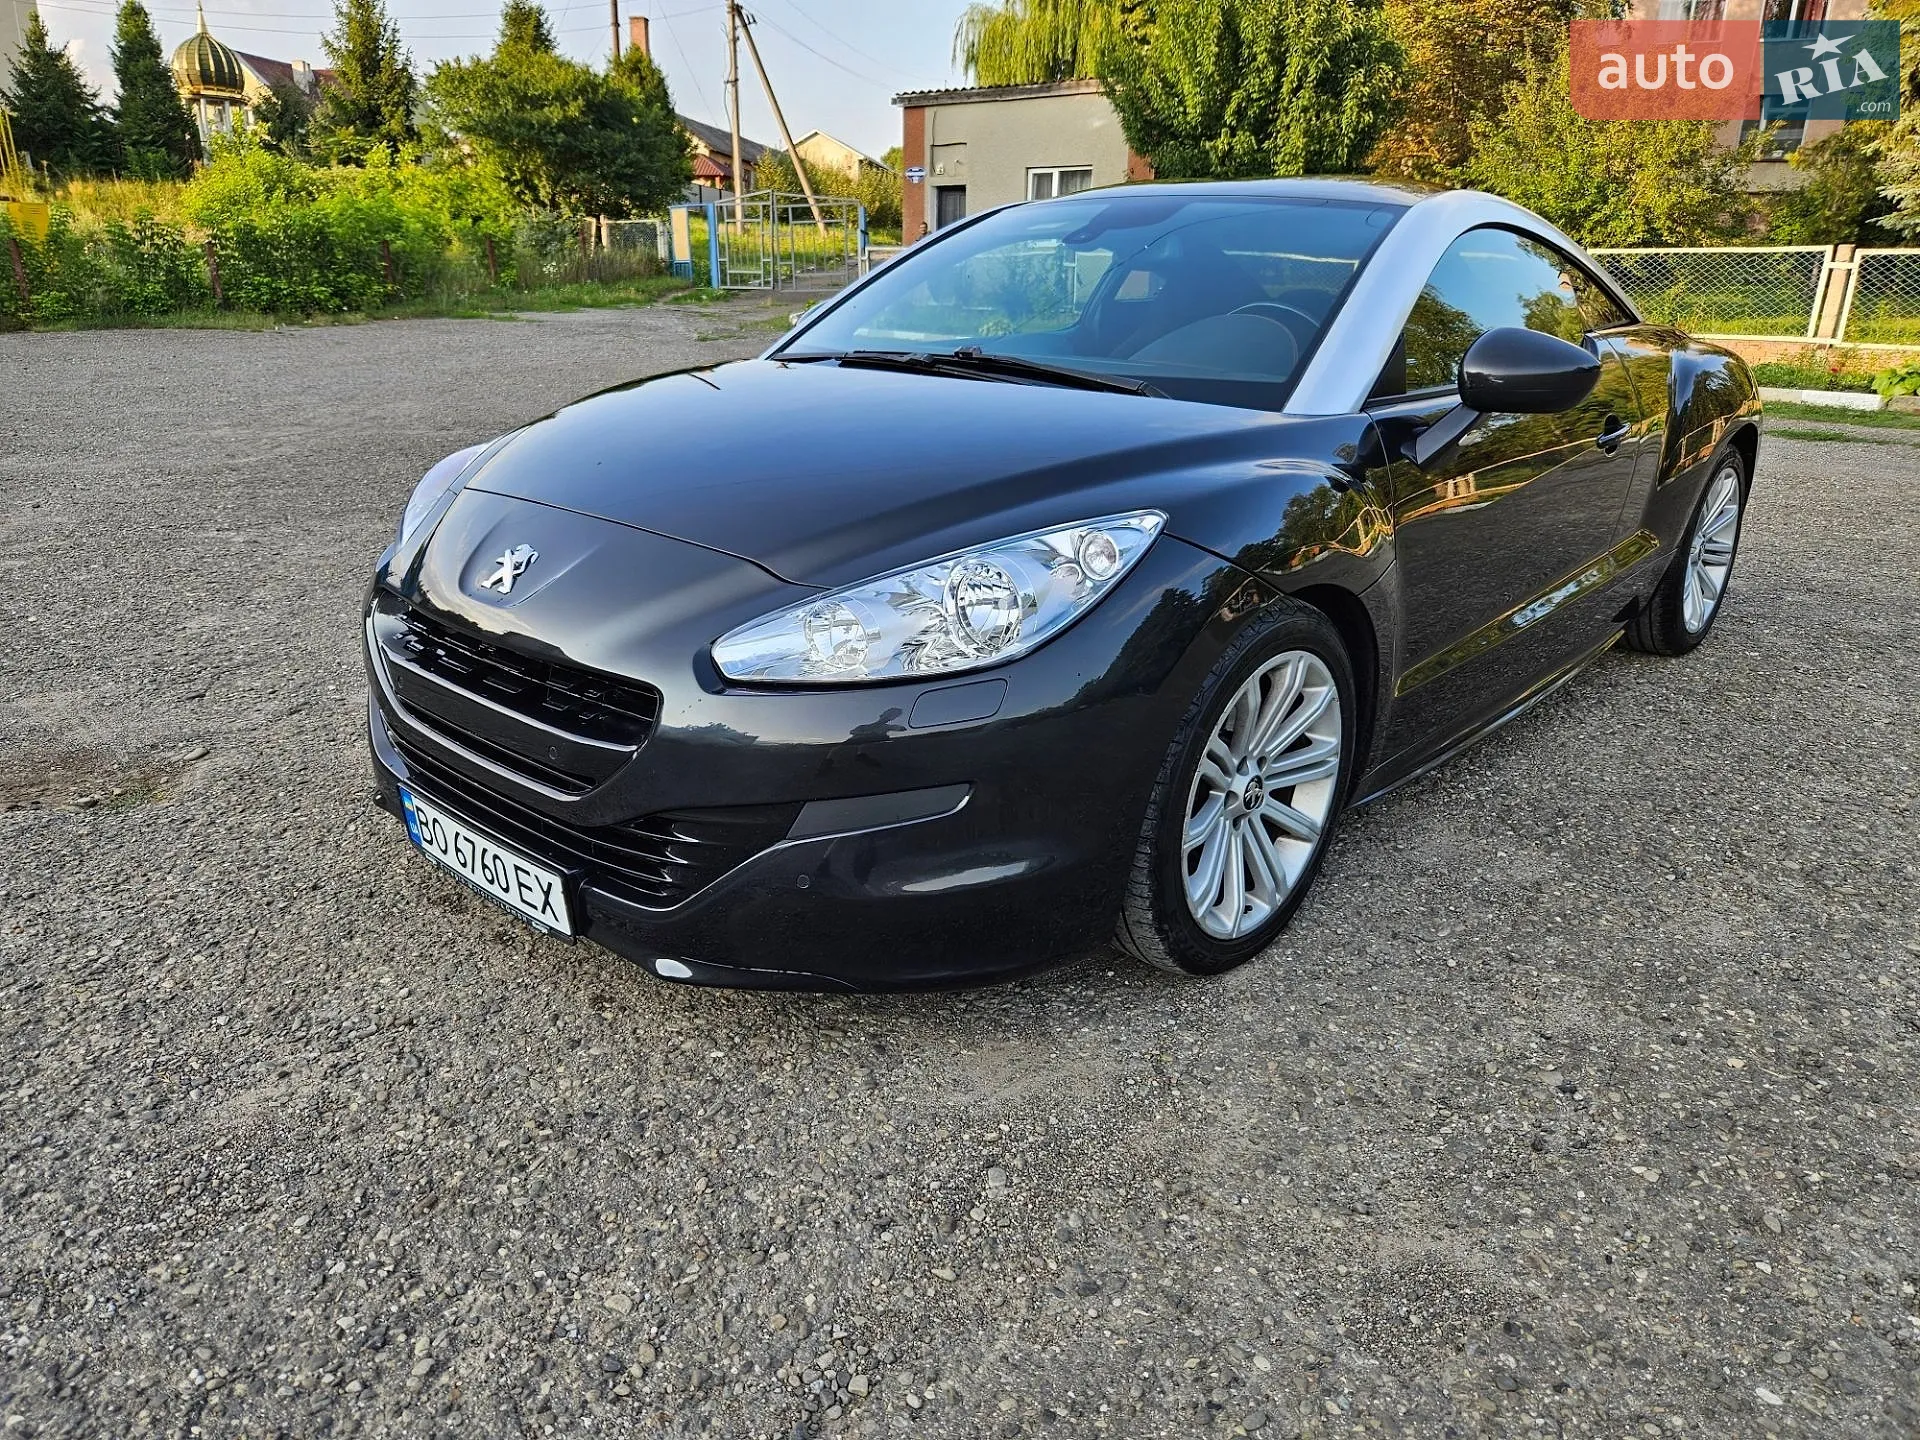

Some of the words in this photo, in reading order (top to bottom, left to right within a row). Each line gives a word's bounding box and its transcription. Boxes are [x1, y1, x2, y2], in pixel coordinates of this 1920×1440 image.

[415, 805, 448, 856] BO
[454, 831, 510, 894] 6760
[513, 863, 559, 923] EX
